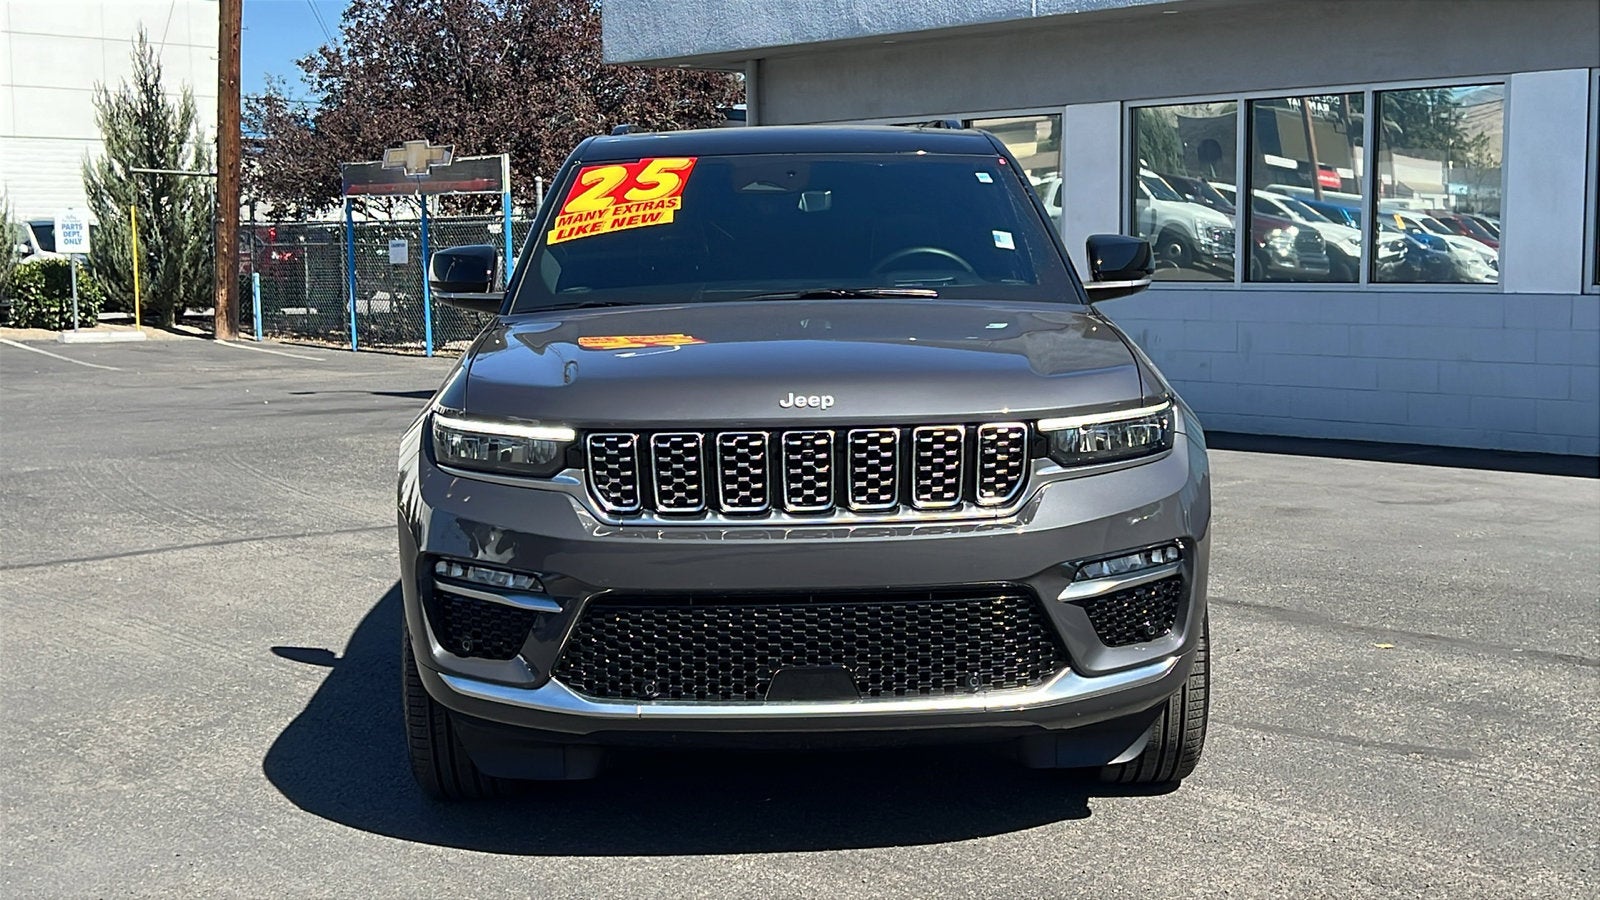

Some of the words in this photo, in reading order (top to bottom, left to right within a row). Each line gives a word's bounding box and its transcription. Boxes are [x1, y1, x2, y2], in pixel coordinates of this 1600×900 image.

[564, 158, 692, 213] 25
[556, 221, 603, 240] LIKE
[610, 212, 664, 229] NEW
[557, 209, 607, 227] MANY
[612, 198, 677, 217] EXTRAS
[61, 223, 83, 231] PARTS
[779, 392, 835, 409] Jeep
